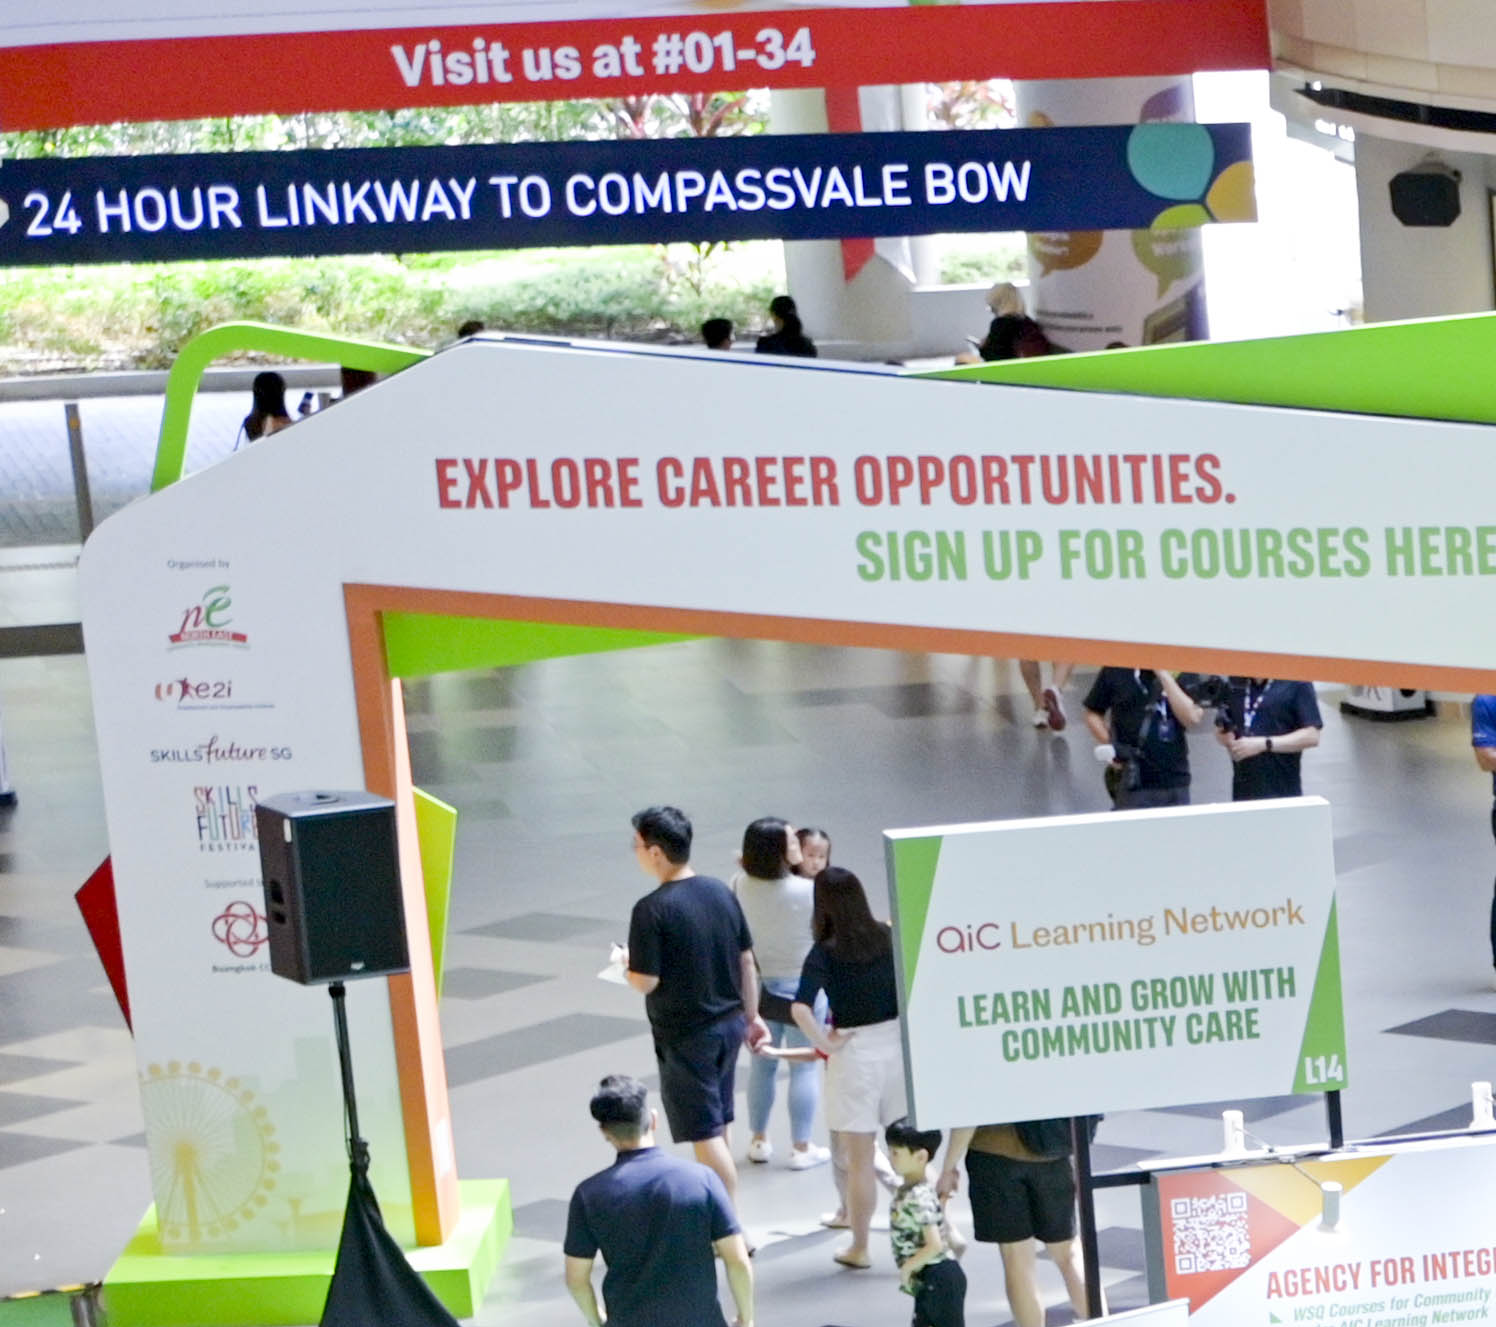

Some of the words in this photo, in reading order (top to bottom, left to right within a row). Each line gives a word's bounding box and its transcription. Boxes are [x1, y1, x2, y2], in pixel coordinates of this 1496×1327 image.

[390, 36, 513, 87] Visit
[521, 45, 582, 82] us
[592, 35, 645, 79] at
[651, 26, 817, 75] #01-34
[23, 190, 83, 237] 24
[95, 184, 243, 234] HOUR
[256, 176, 477, 228] LINKWAY
[488, 174, 552, 219] TO
[565, 163, 912, 217] COMPASSVALE
[924, 160, 1032, 205] BOW
[434, 457, 644, 510] EXPLORE
[655, 455, 840, 509] CAREER
[853, 452, 1237, 507] OPPORTUNITIES.
[855, 529, 968, 583] SIGN
[981, 529, 1044, 582] UP
[1058, 528, 1147, 580] FOR
[1159, 526, 1371, 580] COURSES
[272, 747, 292, 760] SG
[1010, 912, 1157, 950] Learning
[1163, 897, 1306, 937] Network
[957, 987, 1052, 1029] LEARN
[1060, 982, 1123, 1019] AND
[1130, 973, 1215, 1012] GROW
[1221, 965, 1297, 1004] WITH
[1001, 1014, 1177, 1063] COMMUNITY
[1185, 1007, 1261, 1046] CARE
[1305, 1055, 1343, 1084] L14
[1266, 1261, 1362, 1300] AGENCY
[1369, 1256, 1416, 1288] FOR
